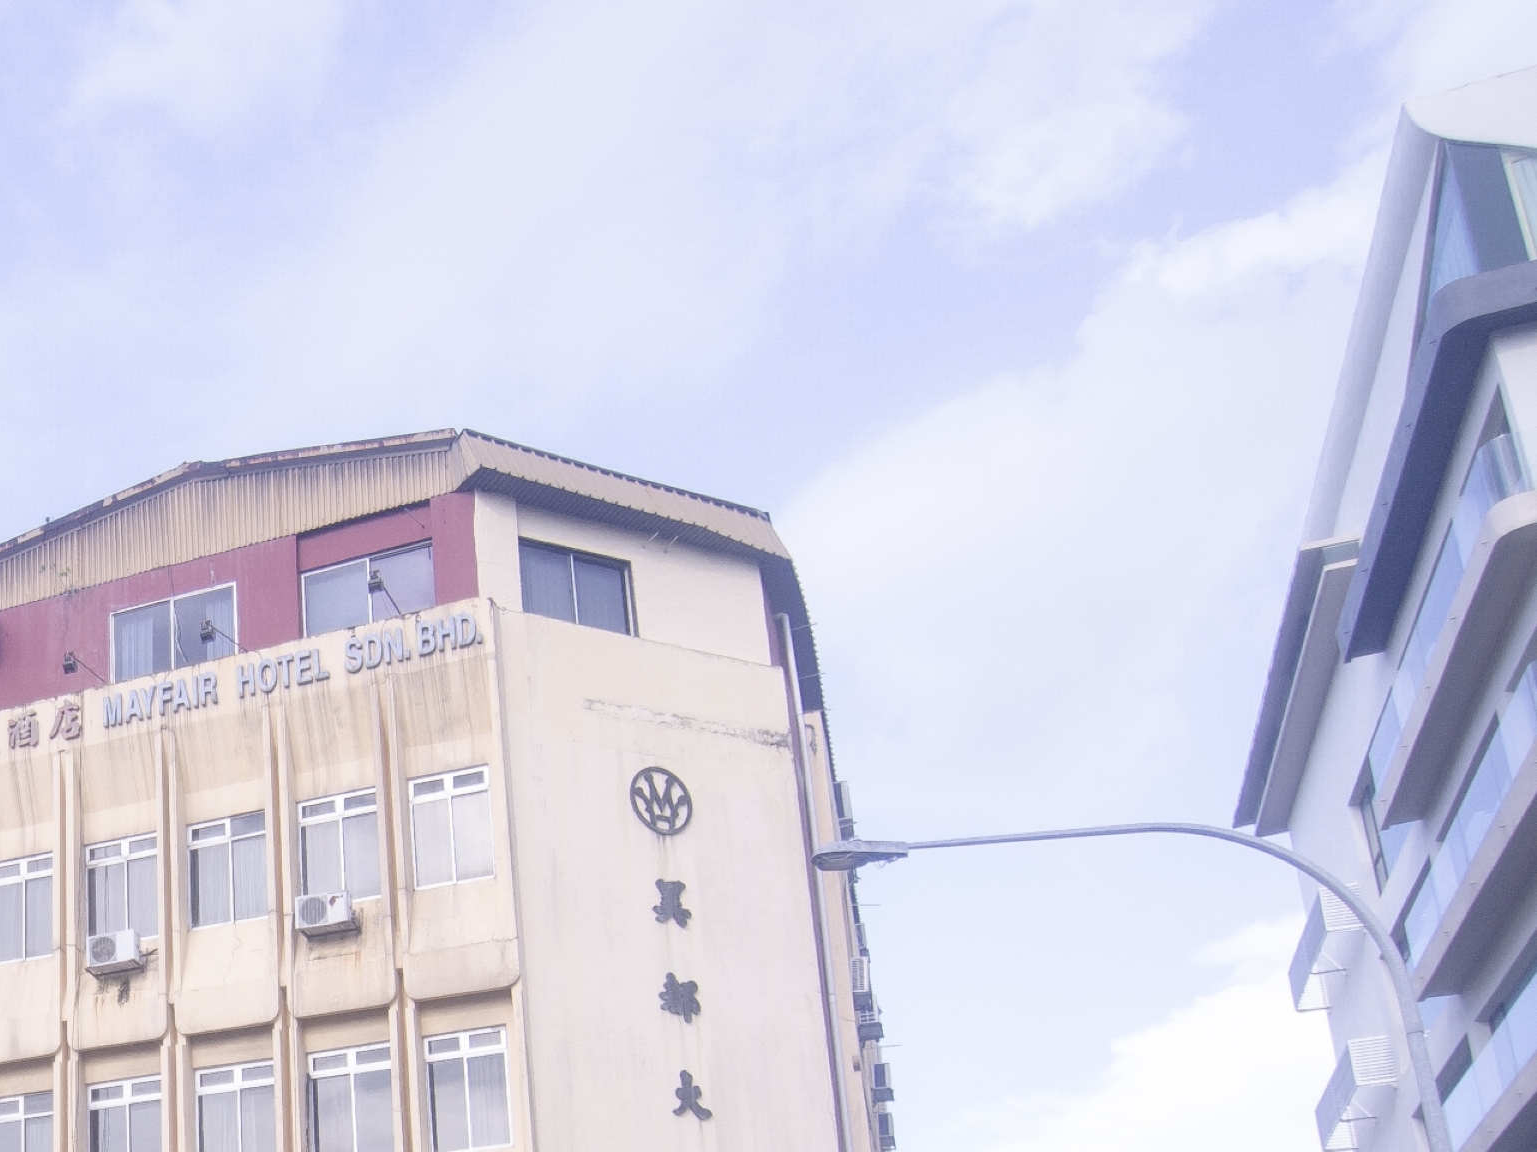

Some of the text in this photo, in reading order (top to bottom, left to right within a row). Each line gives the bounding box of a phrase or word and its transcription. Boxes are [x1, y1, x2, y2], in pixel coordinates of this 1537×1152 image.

[102, 610, 484, 728] MAYFAIR HOTEL SDN. BHD.
